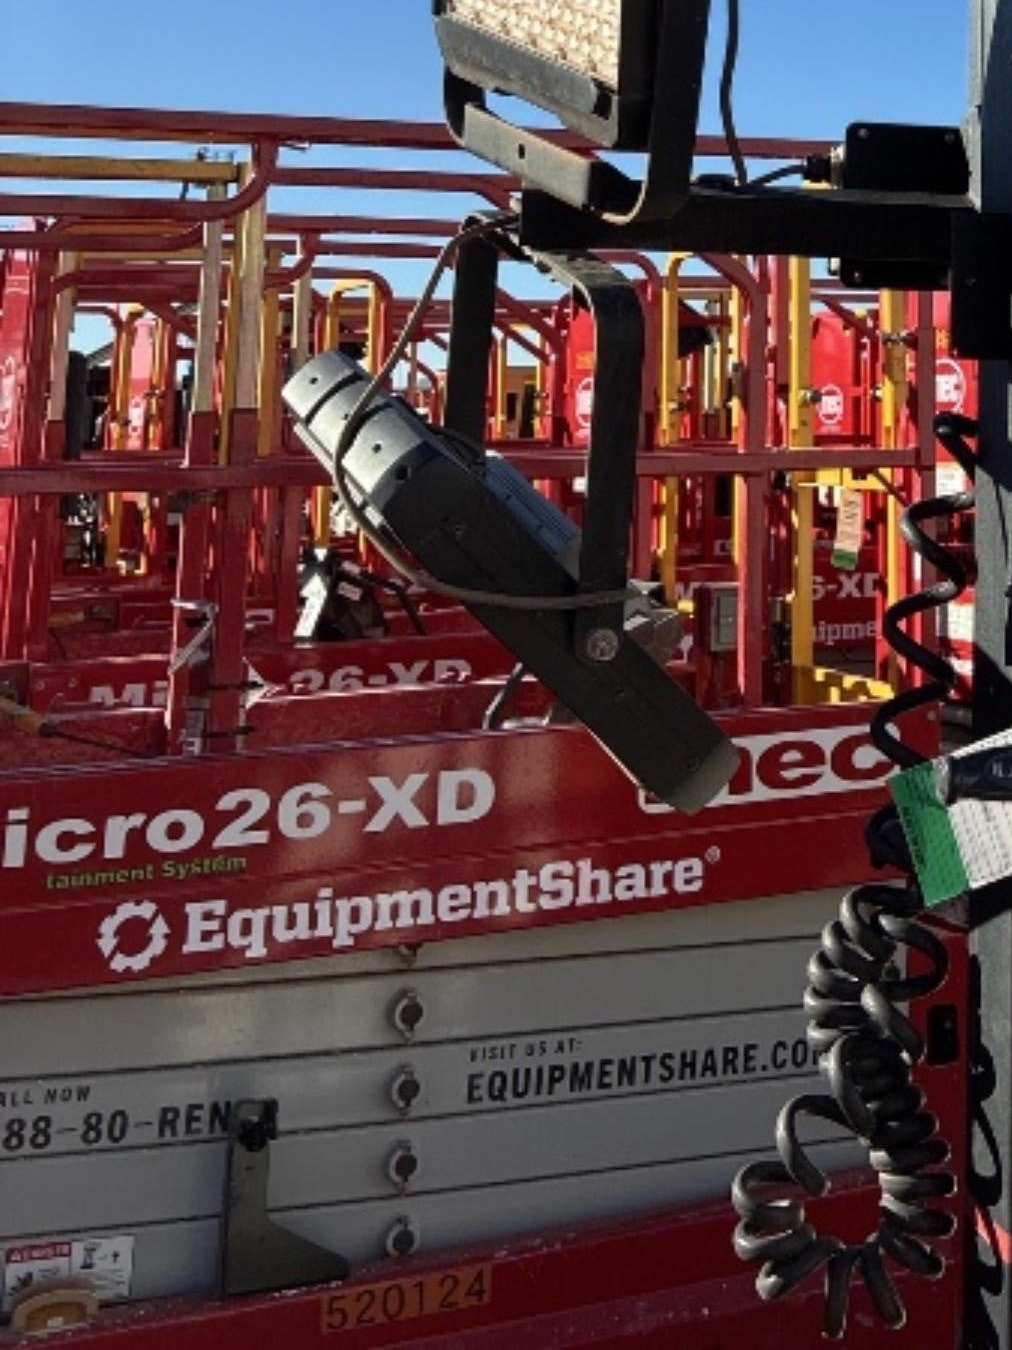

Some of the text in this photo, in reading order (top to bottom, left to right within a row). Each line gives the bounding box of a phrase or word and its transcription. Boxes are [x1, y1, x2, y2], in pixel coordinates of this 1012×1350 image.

[2, 767, 497, 869] icro26-XD
[161, 853, 248, 882] System
[44, 1085, 91, 1105] NOW
[326, 1267, 488, 1331] 520124
